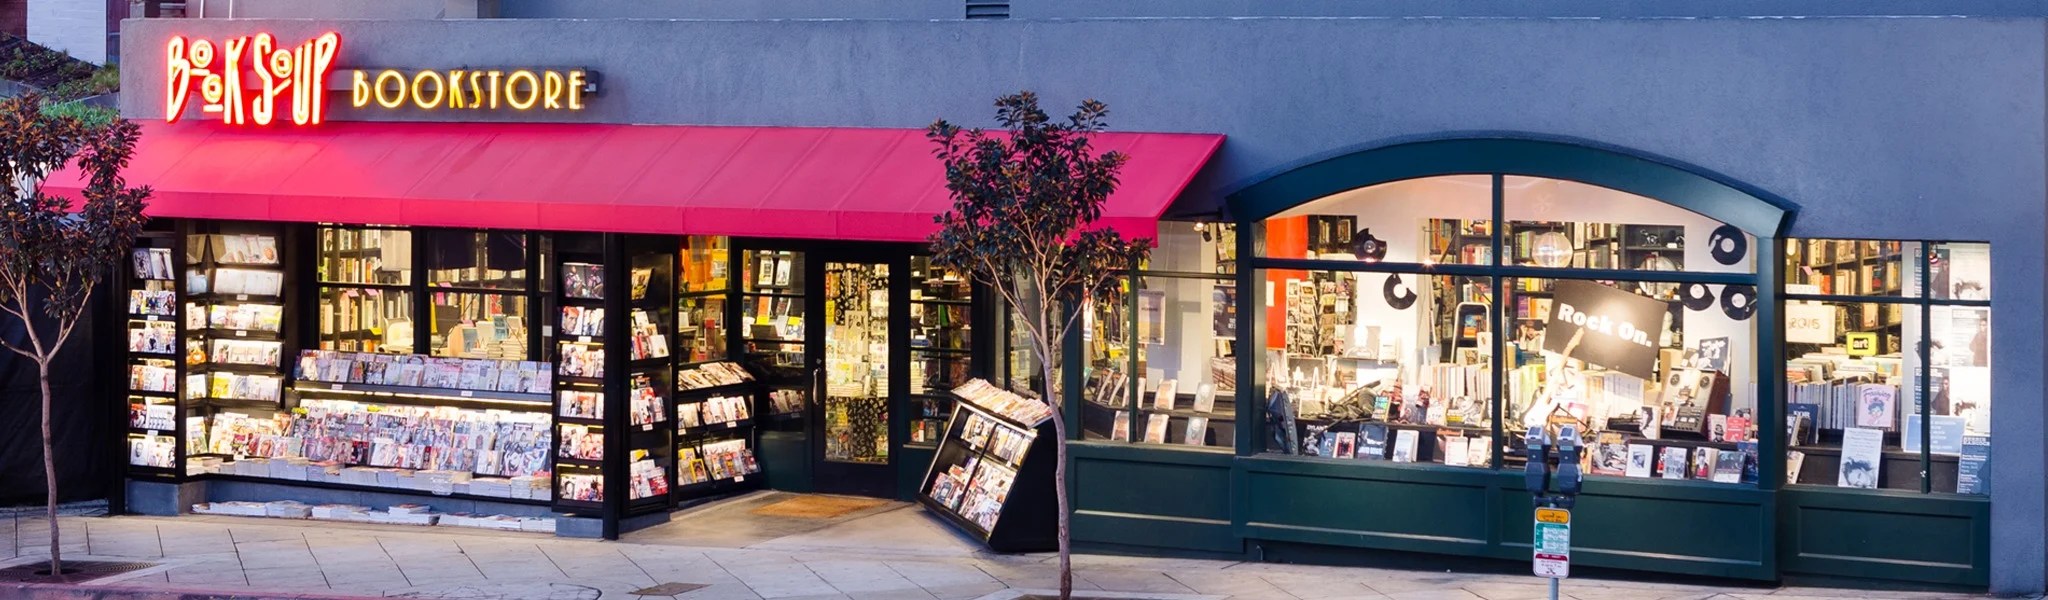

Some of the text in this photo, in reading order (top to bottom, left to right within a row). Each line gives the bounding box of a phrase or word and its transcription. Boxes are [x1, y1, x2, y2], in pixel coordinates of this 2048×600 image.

[352, 69, 587, 110] BOOKSTORE
[1557, 302, 1653, 348] Rock On.
[1788, 318, 1821, 330] 2015
[1852, 338, 1869, 349] art
